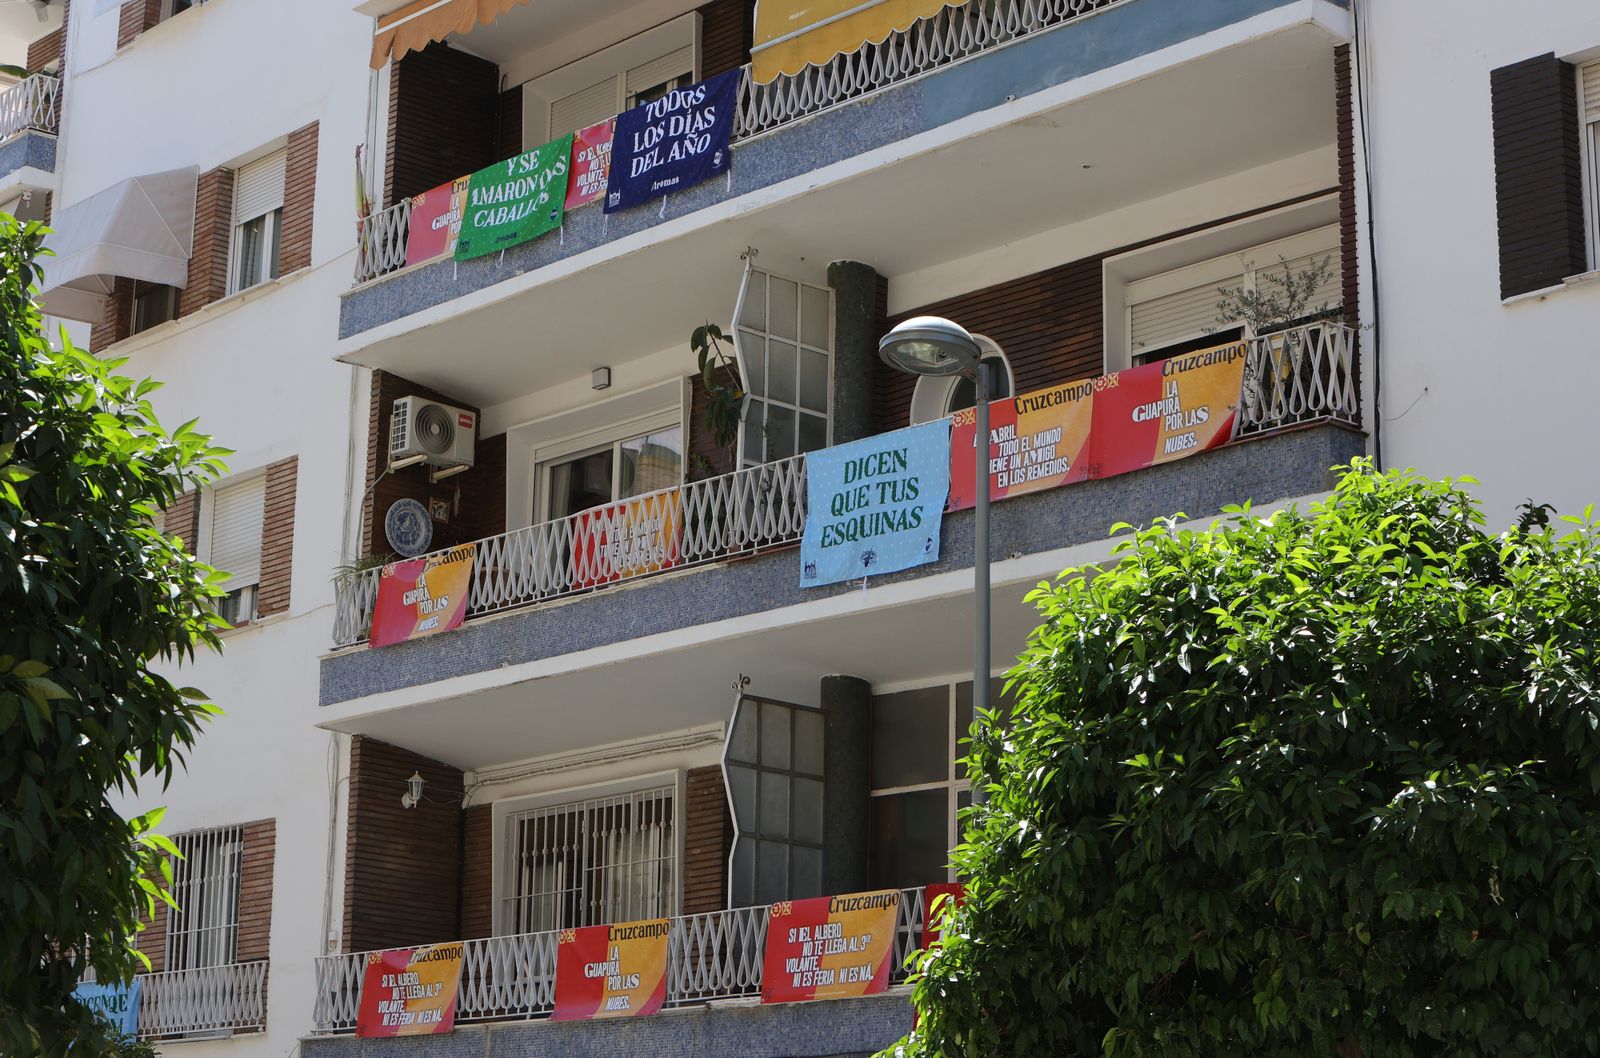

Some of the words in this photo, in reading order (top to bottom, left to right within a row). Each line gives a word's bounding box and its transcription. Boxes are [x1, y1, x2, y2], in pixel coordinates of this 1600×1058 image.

[645, 84, 707, 123] TODOS
[633, 121, 665, 153] LOS
[668, 106, 716, 137] DÍAS
[507, 157, 517, 177] Y
[519, 150, 540, 174] SE
[630, 149, 664, 178] DEL
[668, 133, 711, 162] AÑO
[651, 175, 680, 192] Aromas
[1162, 343, 1247, 377] Cruzcampo
[1014, 381, 1093, 415] Cruzcampo
[1166, 379, 1179, 398] LA
[1131, 396, 1181, 423] GUAPURA
[1165, 410, 1183, 432] POR
[1185, 406, 1209, 427] LAS
[989, 424, 1017, 445] ABRIL
[998, 439, 1019, 457] TODO
[1021, 436, 1031, 452] EL
[1033, 427, 1062, 449] MUNDO
[1164, 432, 1199, 454] NUBES.
[843, 447, 909, 485] DICEN
[989, 456, 1009, 474] IENE
[1010, 453, 1021, 469] UN
[1023, 444, 1056, 467] AMIGO
[998, 472, 1009, 488] EN
[1010, 468, 1026, 486] LOS
[1027, 457, 1071, 481] REMEDIOS.
[831, 484, 871, 518] QUE
[875, 476, 920, 505] TUS
[820, 505, 924, 549] ESQUINAS
[828, 892, 899, 914] Cruzcampo
[608, 921, 670, 942] Cruzcampo
[788, 927, 797, 943] SI
[814, 922, 842, 941] ALBERO
[610, 945, 619, 961] LA
[802, 941, 813, 957] NO
[814, 940, 823, 955] TE
[824, 937, 847, 954] LLEGA
[848, 936, 858, 952] AL
[584, 961, 620, 978] GUAPURA
[607, 975, 621, 991] POR
[622, 973, 640, 989] LAS
[792, 972, 801, 988] NI
[802, 971, 813, 987] ES
[813, 969, 835, 986] FERIA
[838, 968, 848, 984] NI
[848, 966, 859, 982] ES
